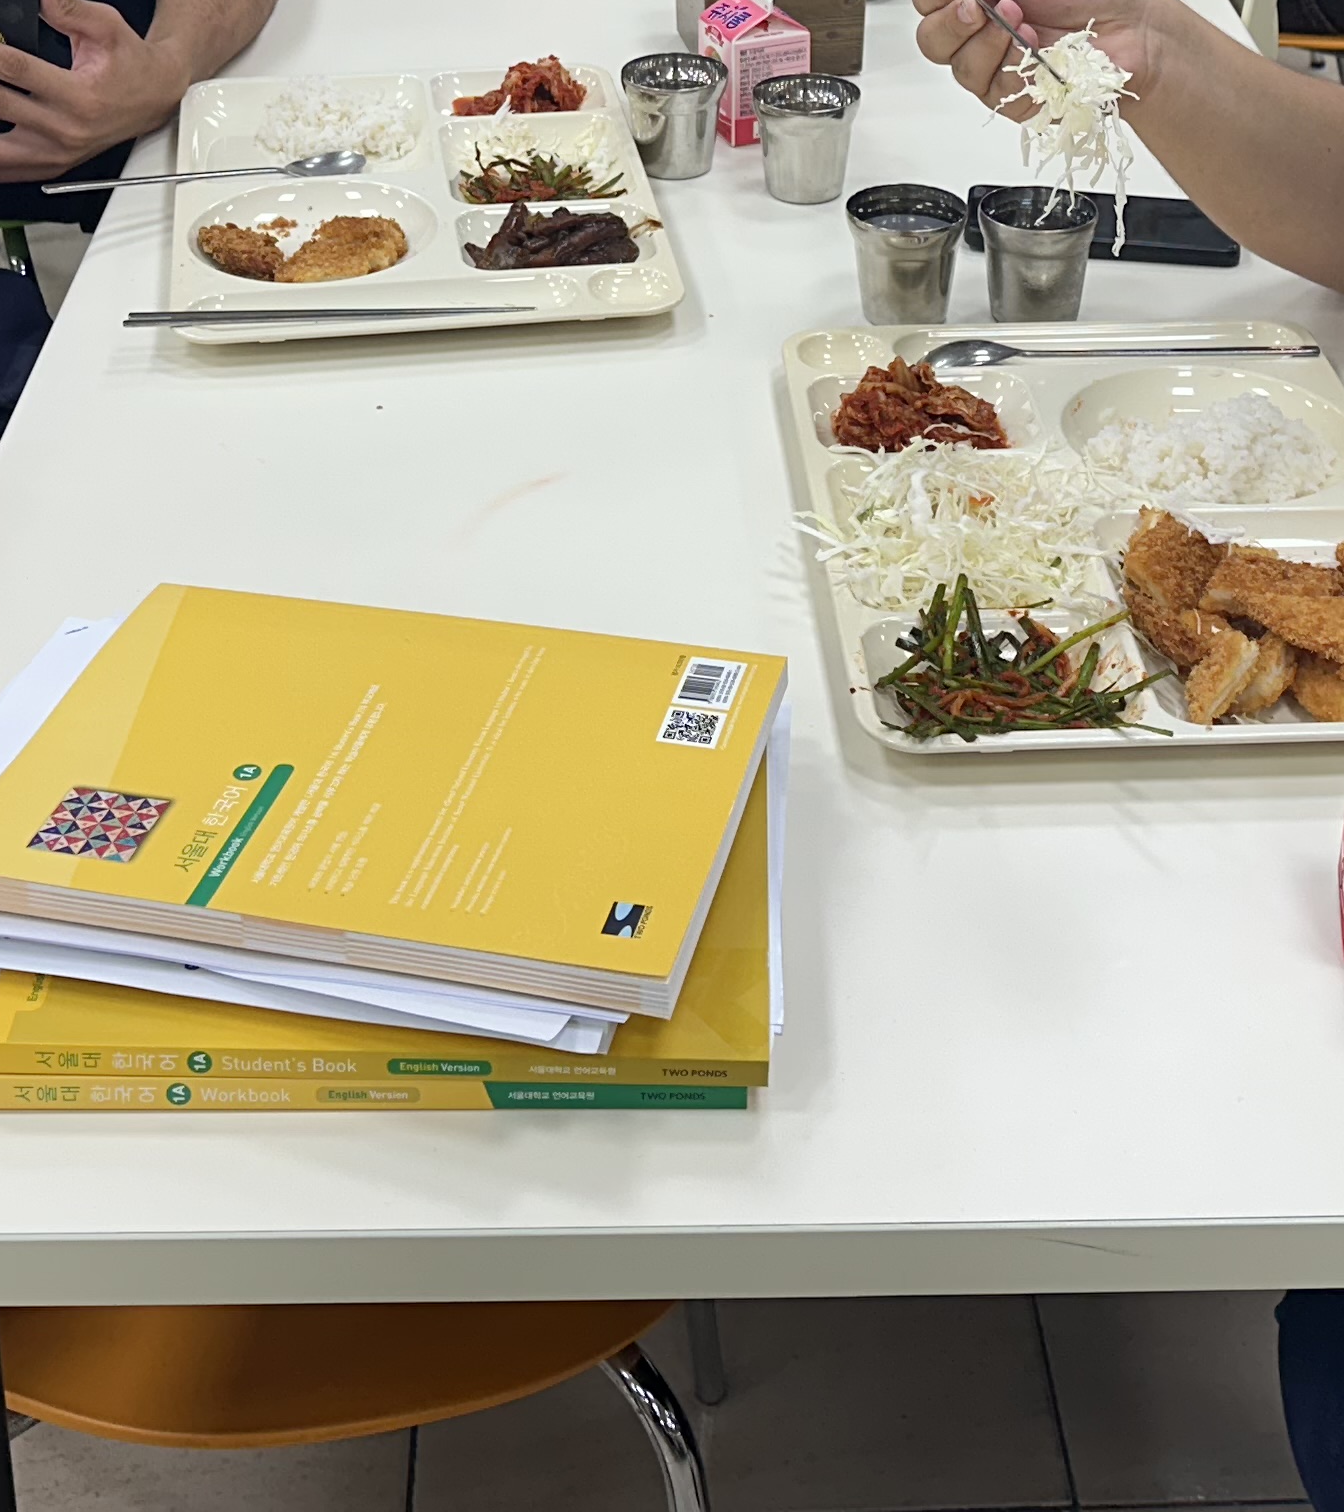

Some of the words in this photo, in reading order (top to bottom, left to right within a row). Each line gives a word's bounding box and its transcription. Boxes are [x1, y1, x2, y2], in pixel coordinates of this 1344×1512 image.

[208, 837, 244, 878] Workbook
[34, 1050, 102, 1069] 서울대
[111, 1053, 179, 1071] 한국어
[193, 1053, 208, 1071] 1A
[221, 1054, 307, 1073] Student's
[312, 1056, 357, 1074] Book
[399, 1062, 439, 1075] English
[440, 1063, 481, 1073] Version
[661, 1068, 689, 1078] TWO
[690, 1068, 728, 1078] PONDS
[13, 1085, 81, 1103] 서울대
[90, 1086, 157, 1103] 한국어
[172, 1084, 186, 1103] 1A
[200, 1087, 291, 1104] Workbook
[328, 1090, 368, 1101] English
[368, 1090, 409, 1100] Version
[640, 1092, 667, 1102] TWO
[668, 1091, 706, 1102] PONDS
